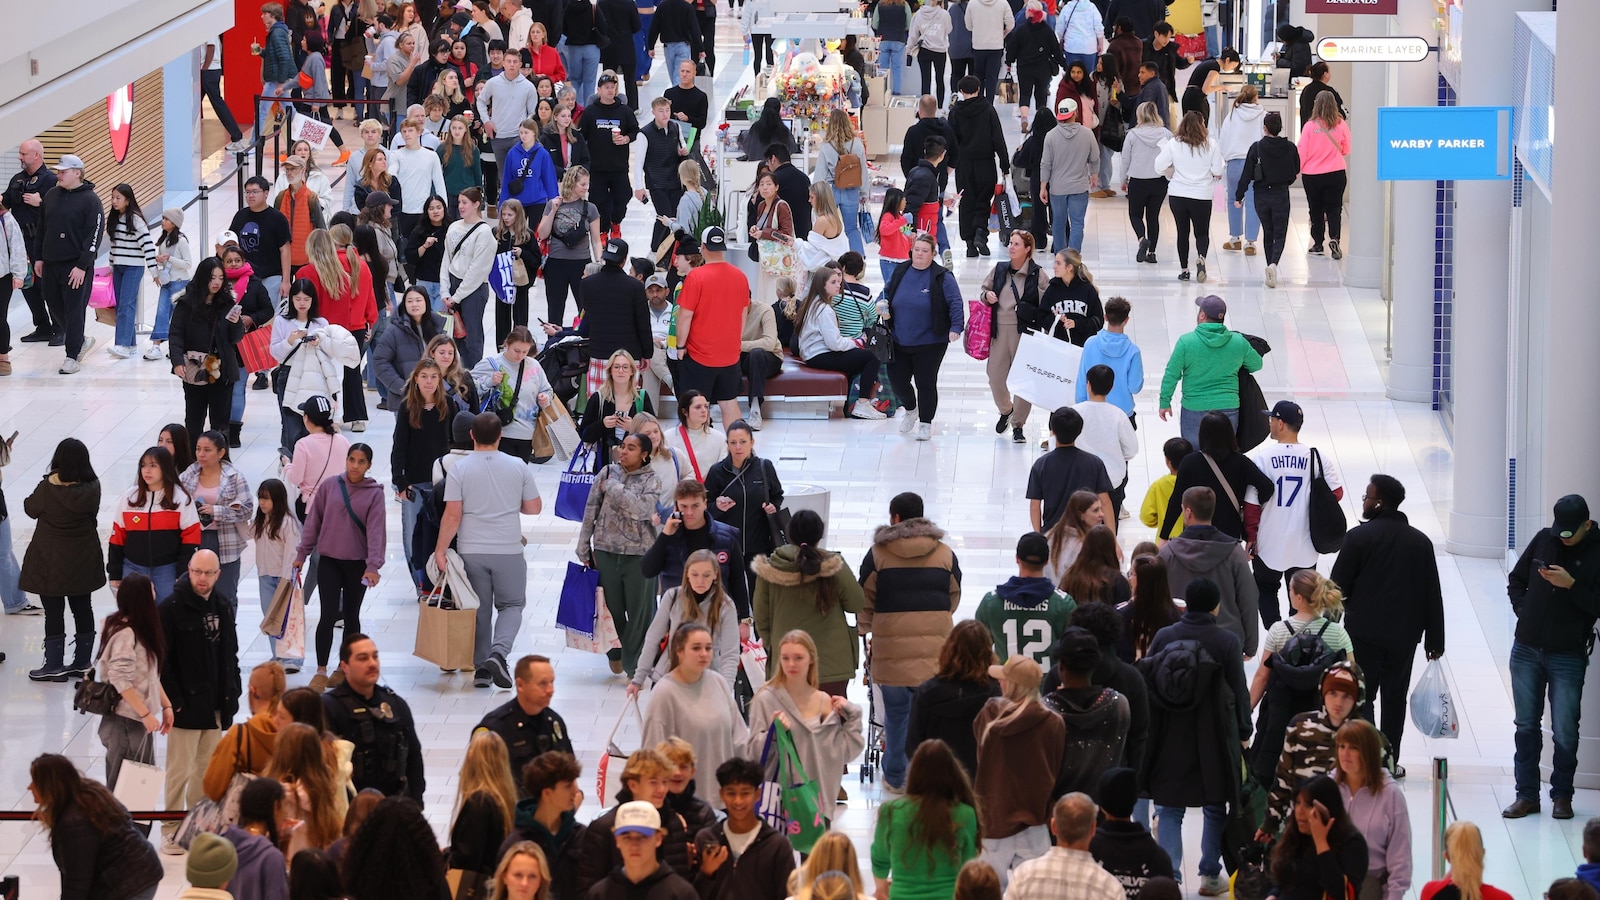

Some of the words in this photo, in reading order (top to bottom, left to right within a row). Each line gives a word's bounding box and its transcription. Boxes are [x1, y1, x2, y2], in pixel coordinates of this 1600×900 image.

[1341, 45, 1384, 54] MARINE
[1388, 45, 1422, 54] LAYER
[1390, 139, 1433, 149] WARBY
[1438, 139, 1485, 149] PARKER
[1026, 363, 1038, 373] THE
[1037, 368, 1056, 379] SUPER
[1056, 375, 1073, 384] PUFF
[1271, 455, 1308, 471] OHTANI
[1276, 475, 1304, 507] 17
[1003, 618, 1052, 675] 12
